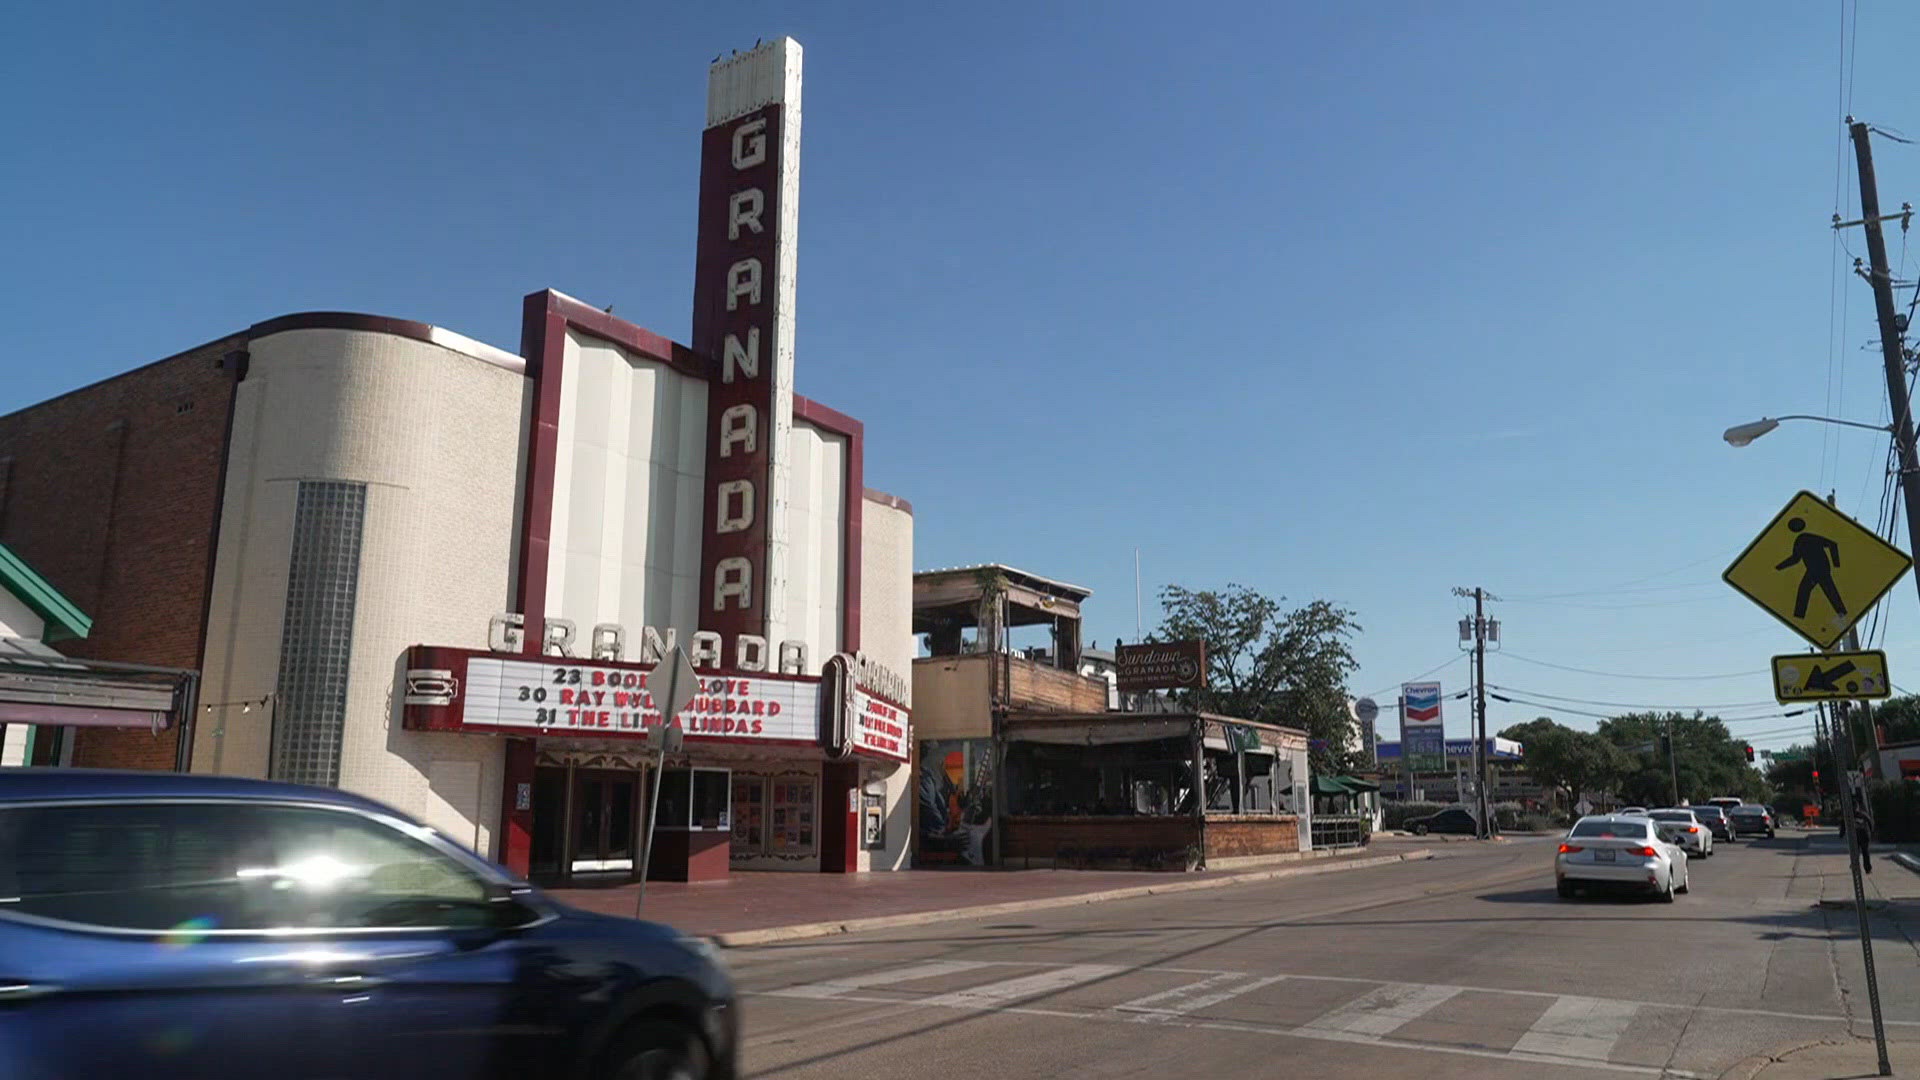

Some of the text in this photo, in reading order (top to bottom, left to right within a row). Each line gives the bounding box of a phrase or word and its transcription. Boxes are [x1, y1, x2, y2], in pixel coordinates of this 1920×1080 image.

[714, 118, 766, 611] GRANADA
[488, 613, 809, 676] GRANADA
[1118, 648, 1180, 667] Sundown
[553, 668, 581, 685] 23
[699, 678, 750, 697] LOVE
[1125, 665, 1177, 676] GRANADA
[518, 686, 547, 703] 30
[559, 688, 606, 707] RAY
[535, 708, 557, 725] 31
[566, 709, 610, 728] THE
[690, 716, 763, 734] LINDAS
